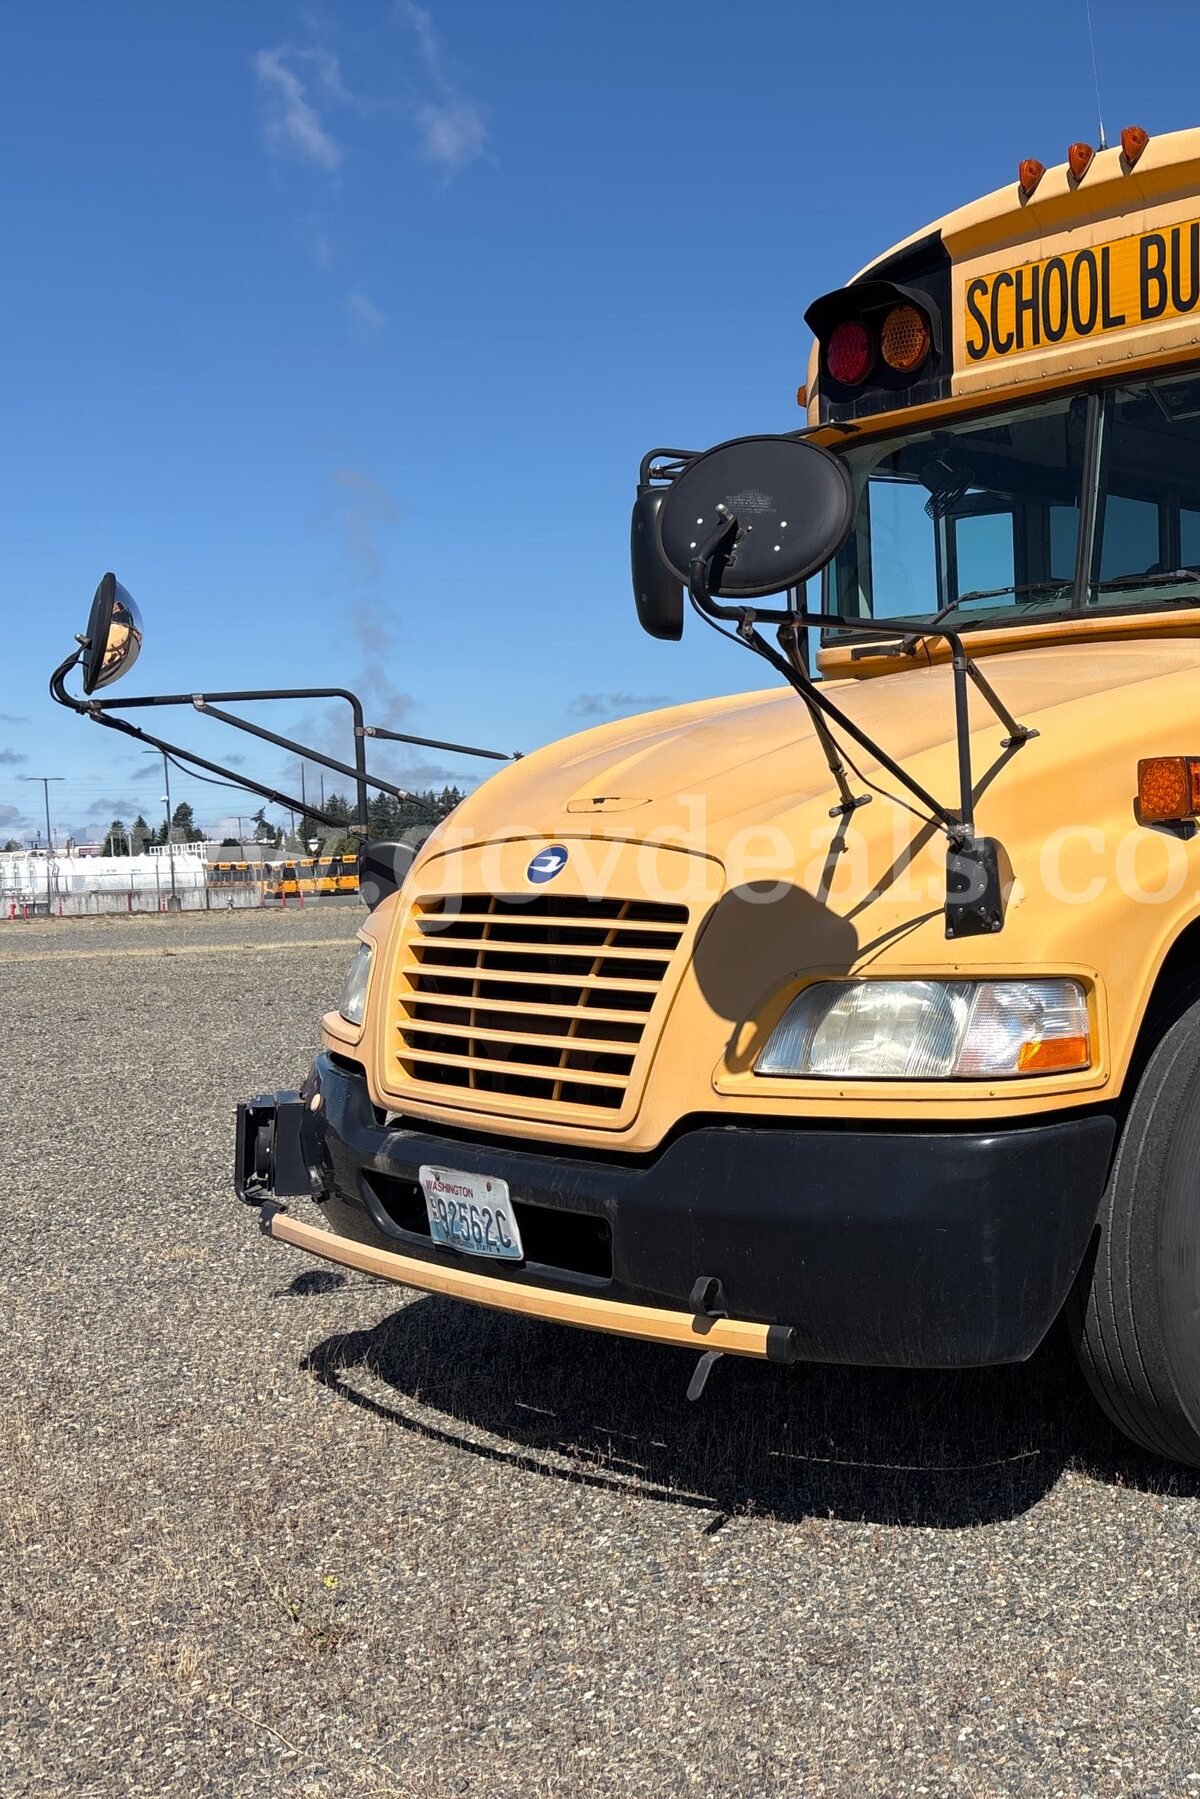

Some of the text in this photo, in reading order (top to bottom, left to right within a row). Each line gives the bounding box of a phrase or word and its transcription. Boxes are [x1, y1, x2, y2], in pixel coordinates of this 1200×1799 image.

[966, 246, 1126, 360] SCHOOL
[425, 1179, 474, 1199] WASHINGTON
[437, 1197, 512, 1249] 92562C
